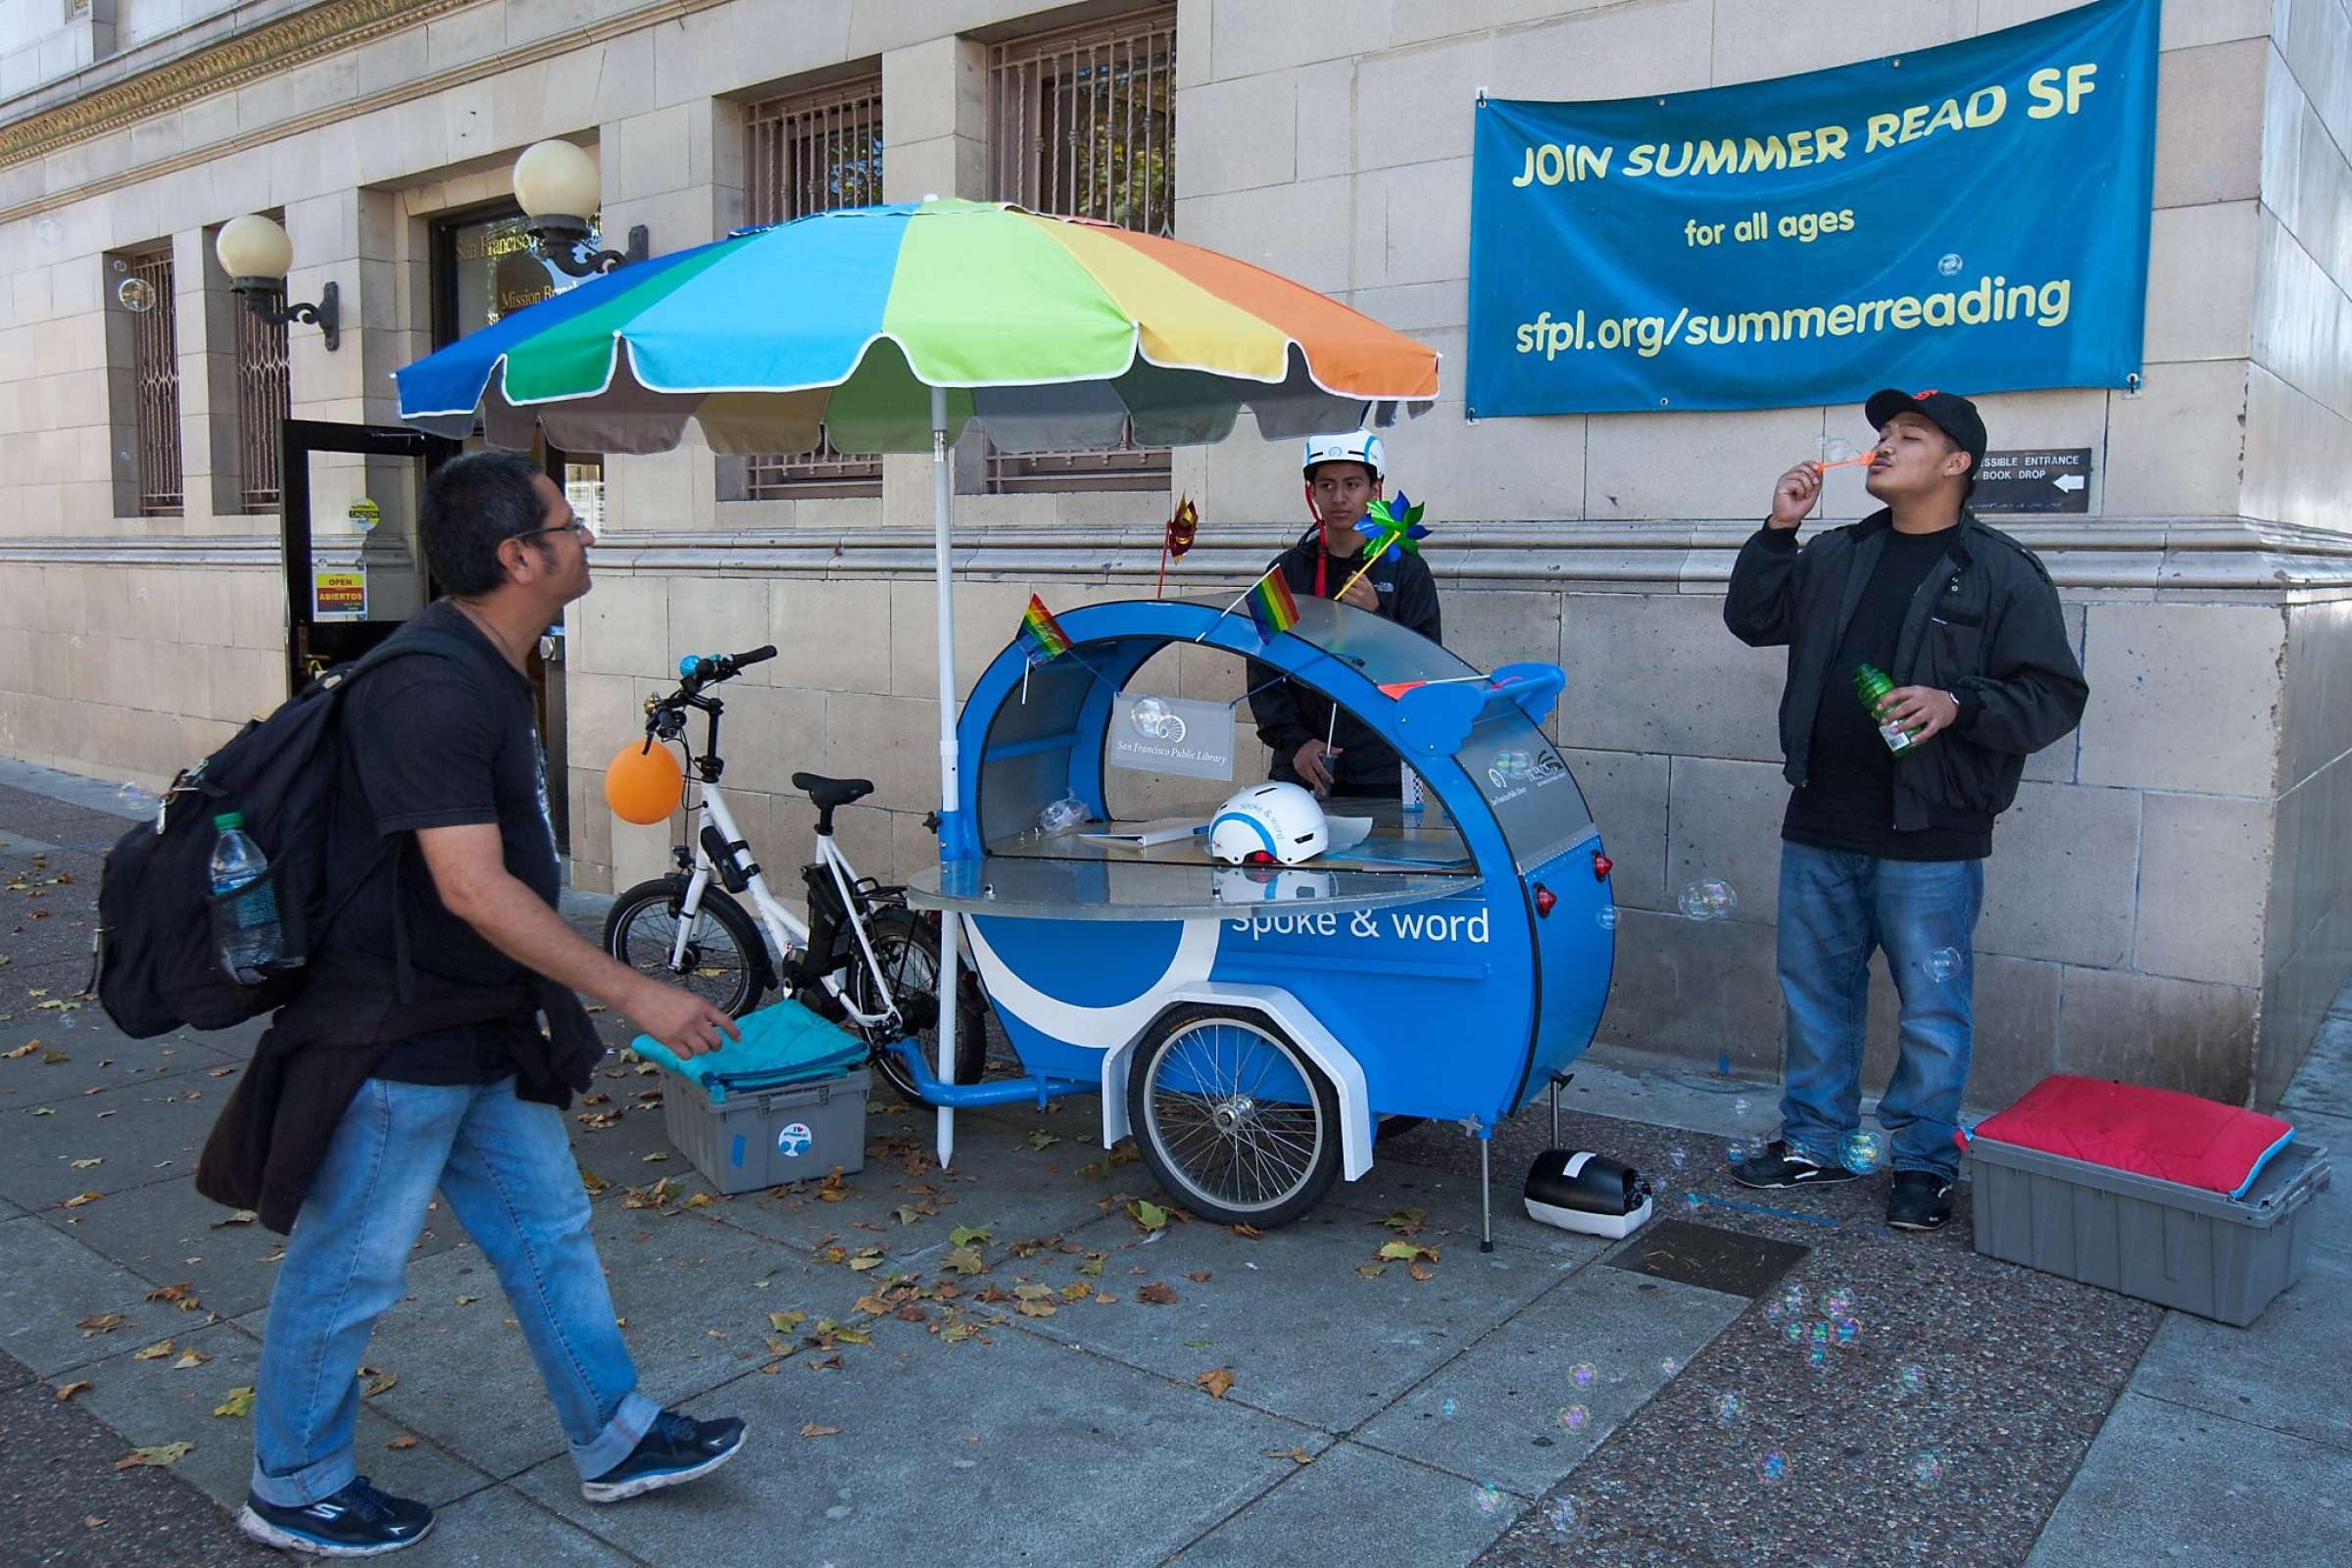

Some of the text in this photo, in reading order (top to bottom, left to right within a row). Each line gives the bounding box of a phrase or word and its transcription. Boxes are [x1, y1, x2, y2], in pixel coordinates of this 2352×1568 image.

[1513, 63, 2098, 187] JOIN SUMMER READ SF
[1685, 208, 1855, 247] for all ages
[457, 241, 477, 260] San
[502, 289, 541, 309] Mission
[1515, 276, 2072, 362] sfpl.org/summerreading
[2025, 455, 2080, 466] ENTRANCE
[1983, 469, 2046, 480] BOOK DROP
[1117, 740, 1227, 765] San Francisco Public Library
[1349, 909, 1381, 938] &
[1392, 907, 1490, 944] word
